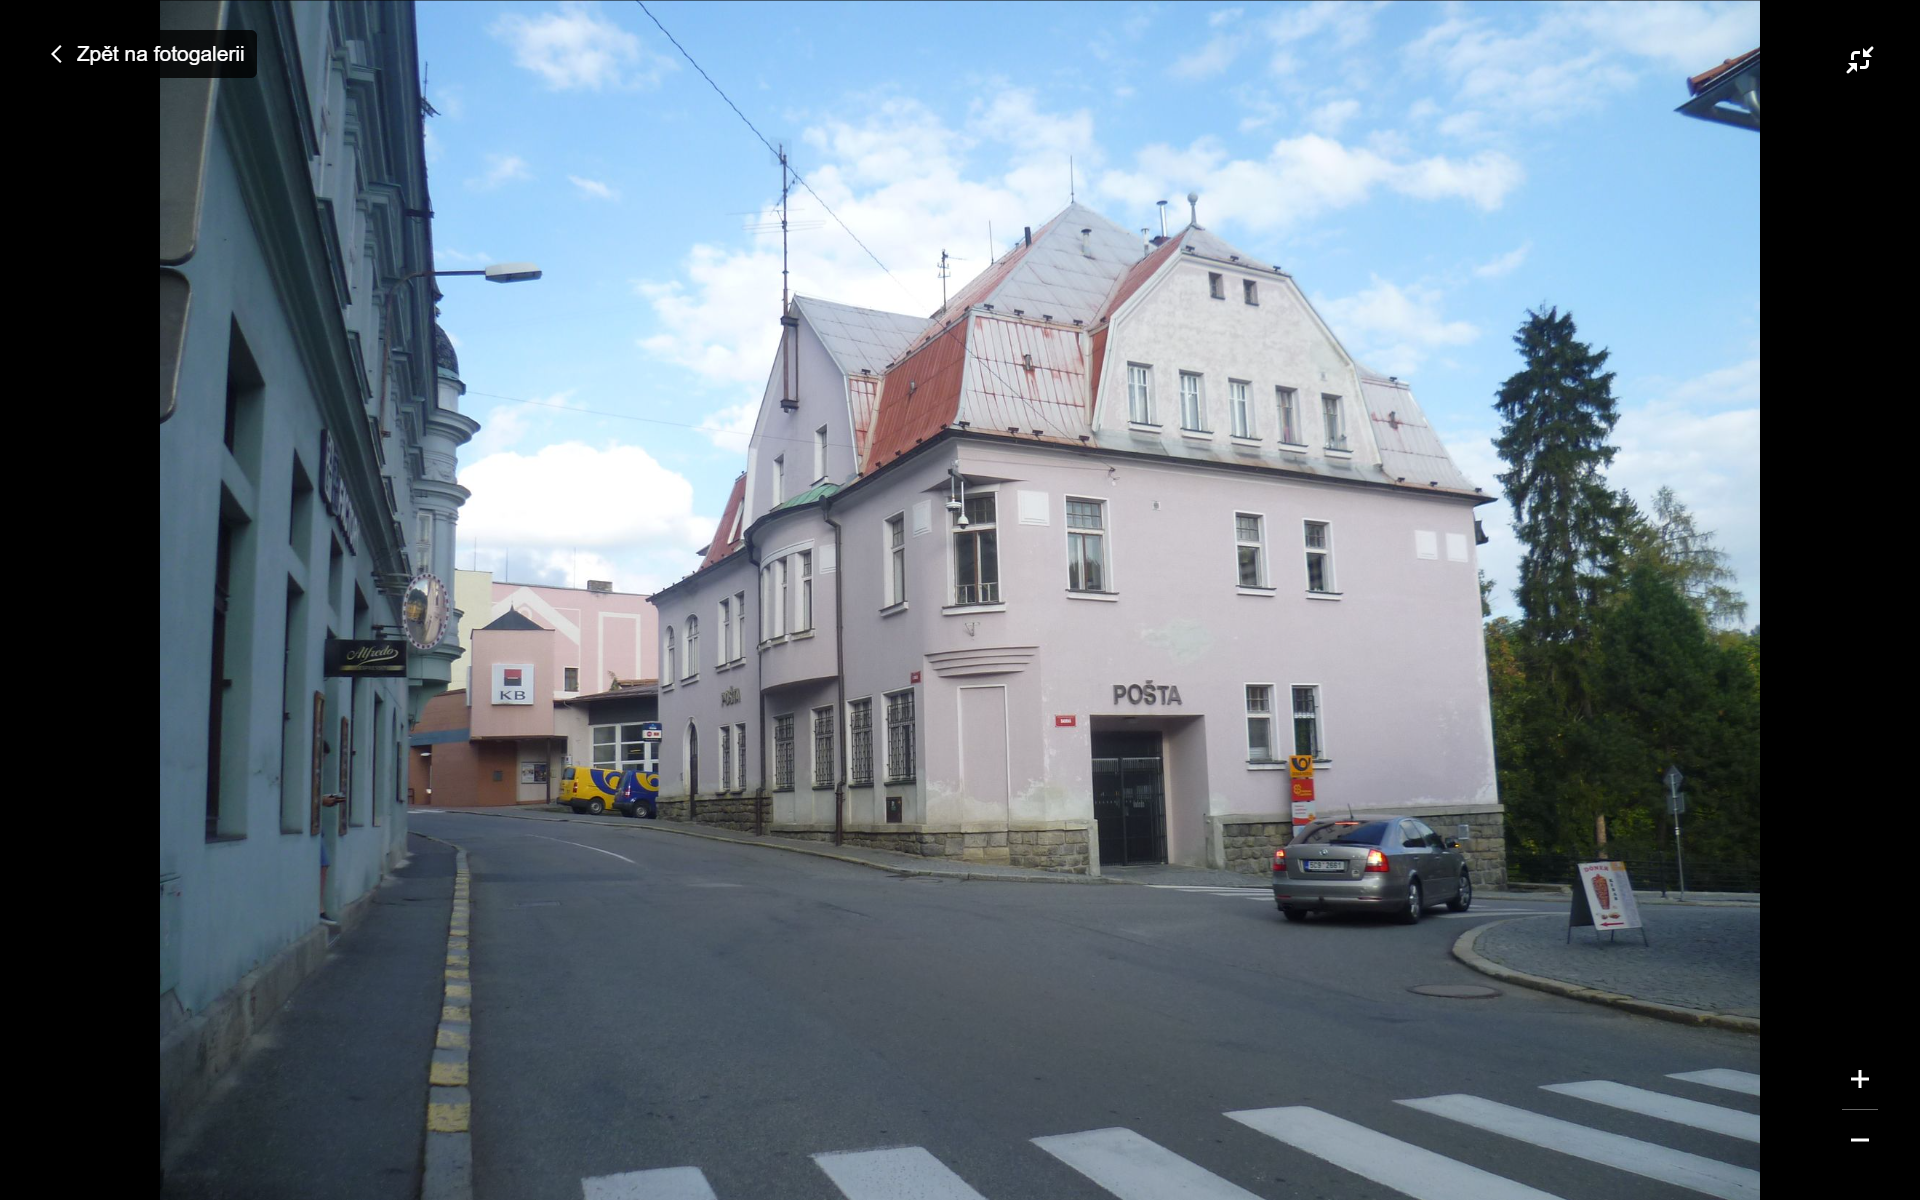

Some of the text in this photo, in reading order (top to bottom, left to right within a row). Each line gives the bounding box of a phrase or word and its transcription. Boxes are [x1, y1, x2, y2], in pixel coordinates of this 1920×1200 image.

[346, 645, 399, 661] Alfredo
[500, 690, 526, 700] KB
[1113, 680, 1182, 705] POŠTA
